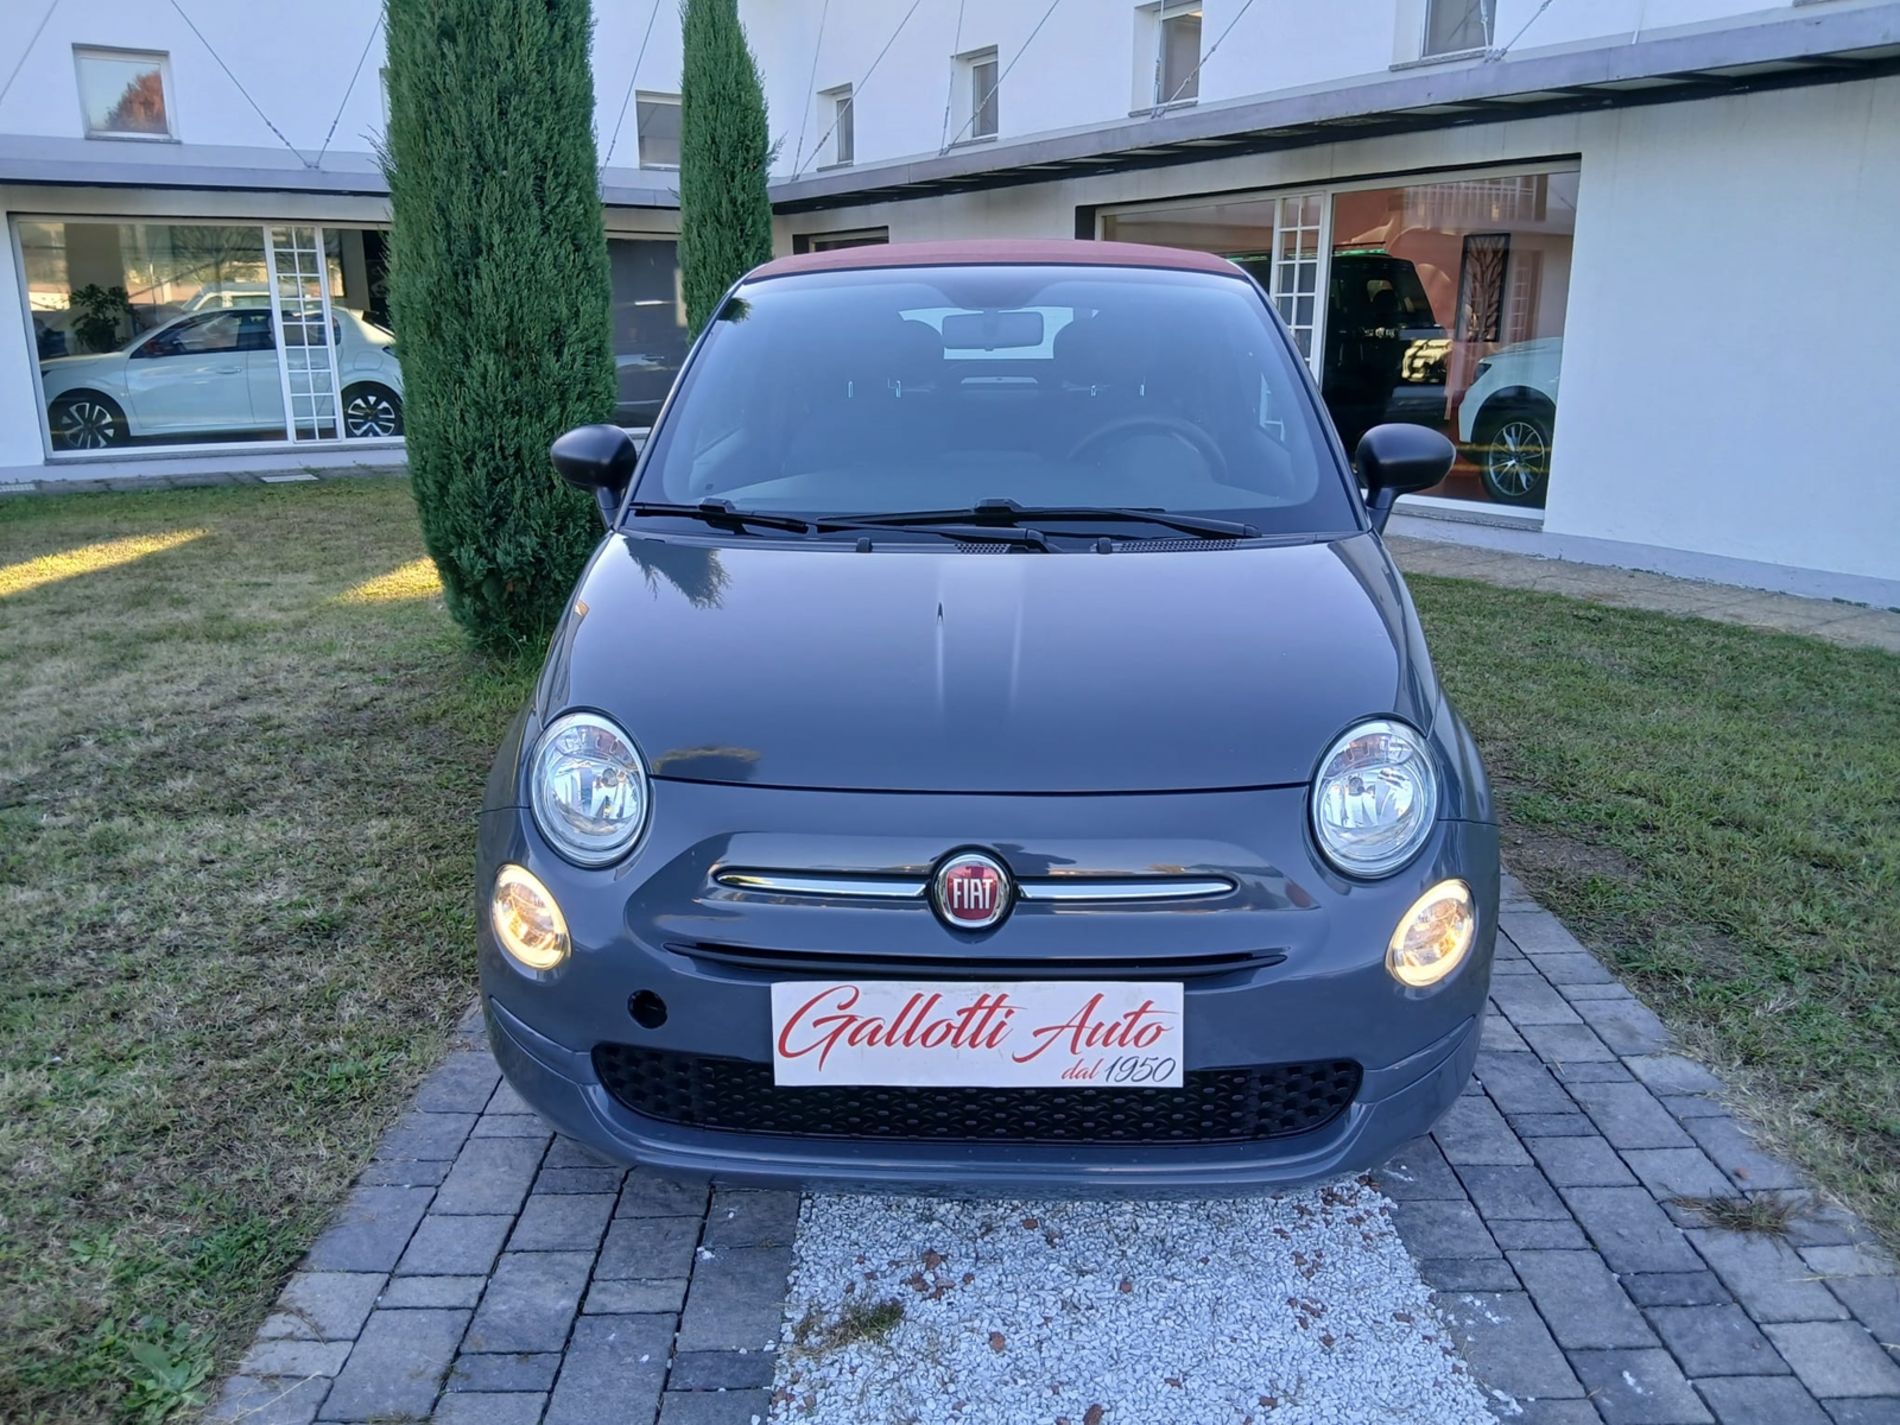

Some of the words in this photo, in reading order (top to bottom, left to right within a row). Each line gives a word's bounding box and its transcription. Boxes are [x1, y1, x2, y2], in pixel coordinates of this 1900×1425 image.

[953, 878, 993, 909] FIAT
[778, 985, 1026, 1072] Gallotti
[1012, 993, 1179, 1063] Auto
[1061, 1058, 1099, 1080] dal
[1105, 1056, 1177, 1083] 1950
